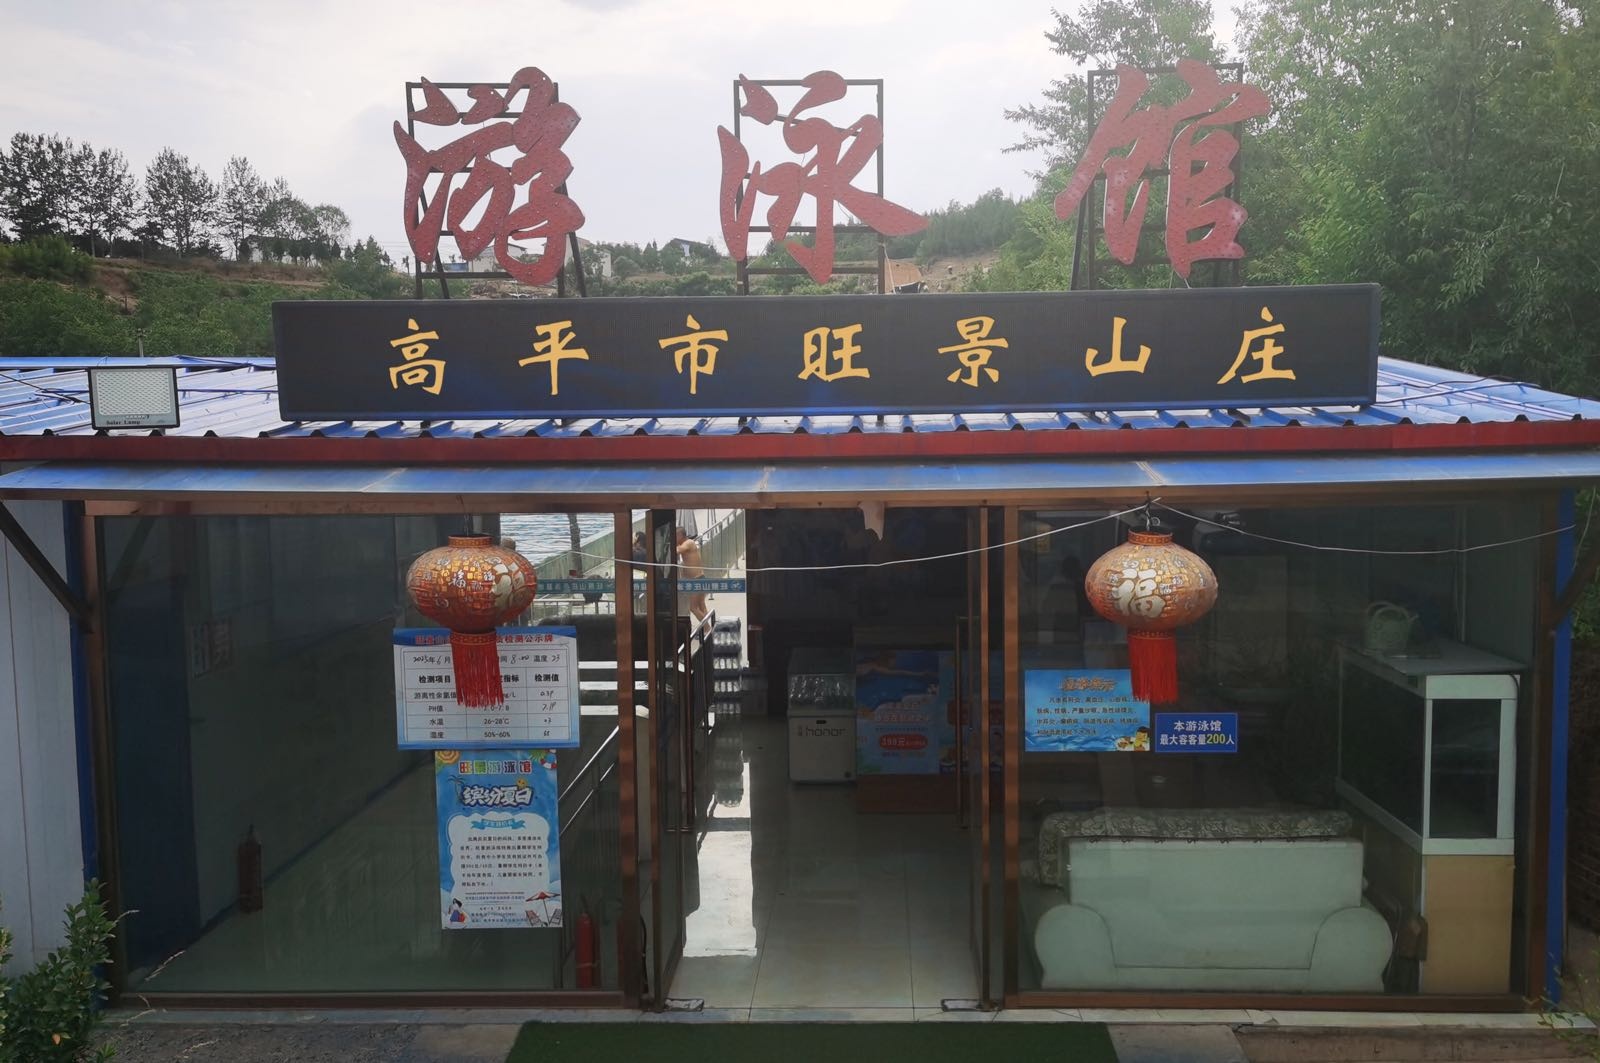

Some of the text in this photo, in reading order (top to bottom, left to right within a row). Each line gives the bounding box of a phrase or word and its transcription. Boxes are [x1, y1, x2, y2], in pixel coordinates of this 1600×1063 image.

[393, 58, 1270, 286] 游泳馆
[388, 307, 1297, 396] 高平市旺景山庄
[418, 674, 450, 684] 检测项目
[534, 673, 560, 683] 检测值
[1173, 720, 1222, 732] 本游泳馆
[1159, 733, 1235, 745] 最大容客量200人
[462, 785, 532, 806] 缤纷夏日
